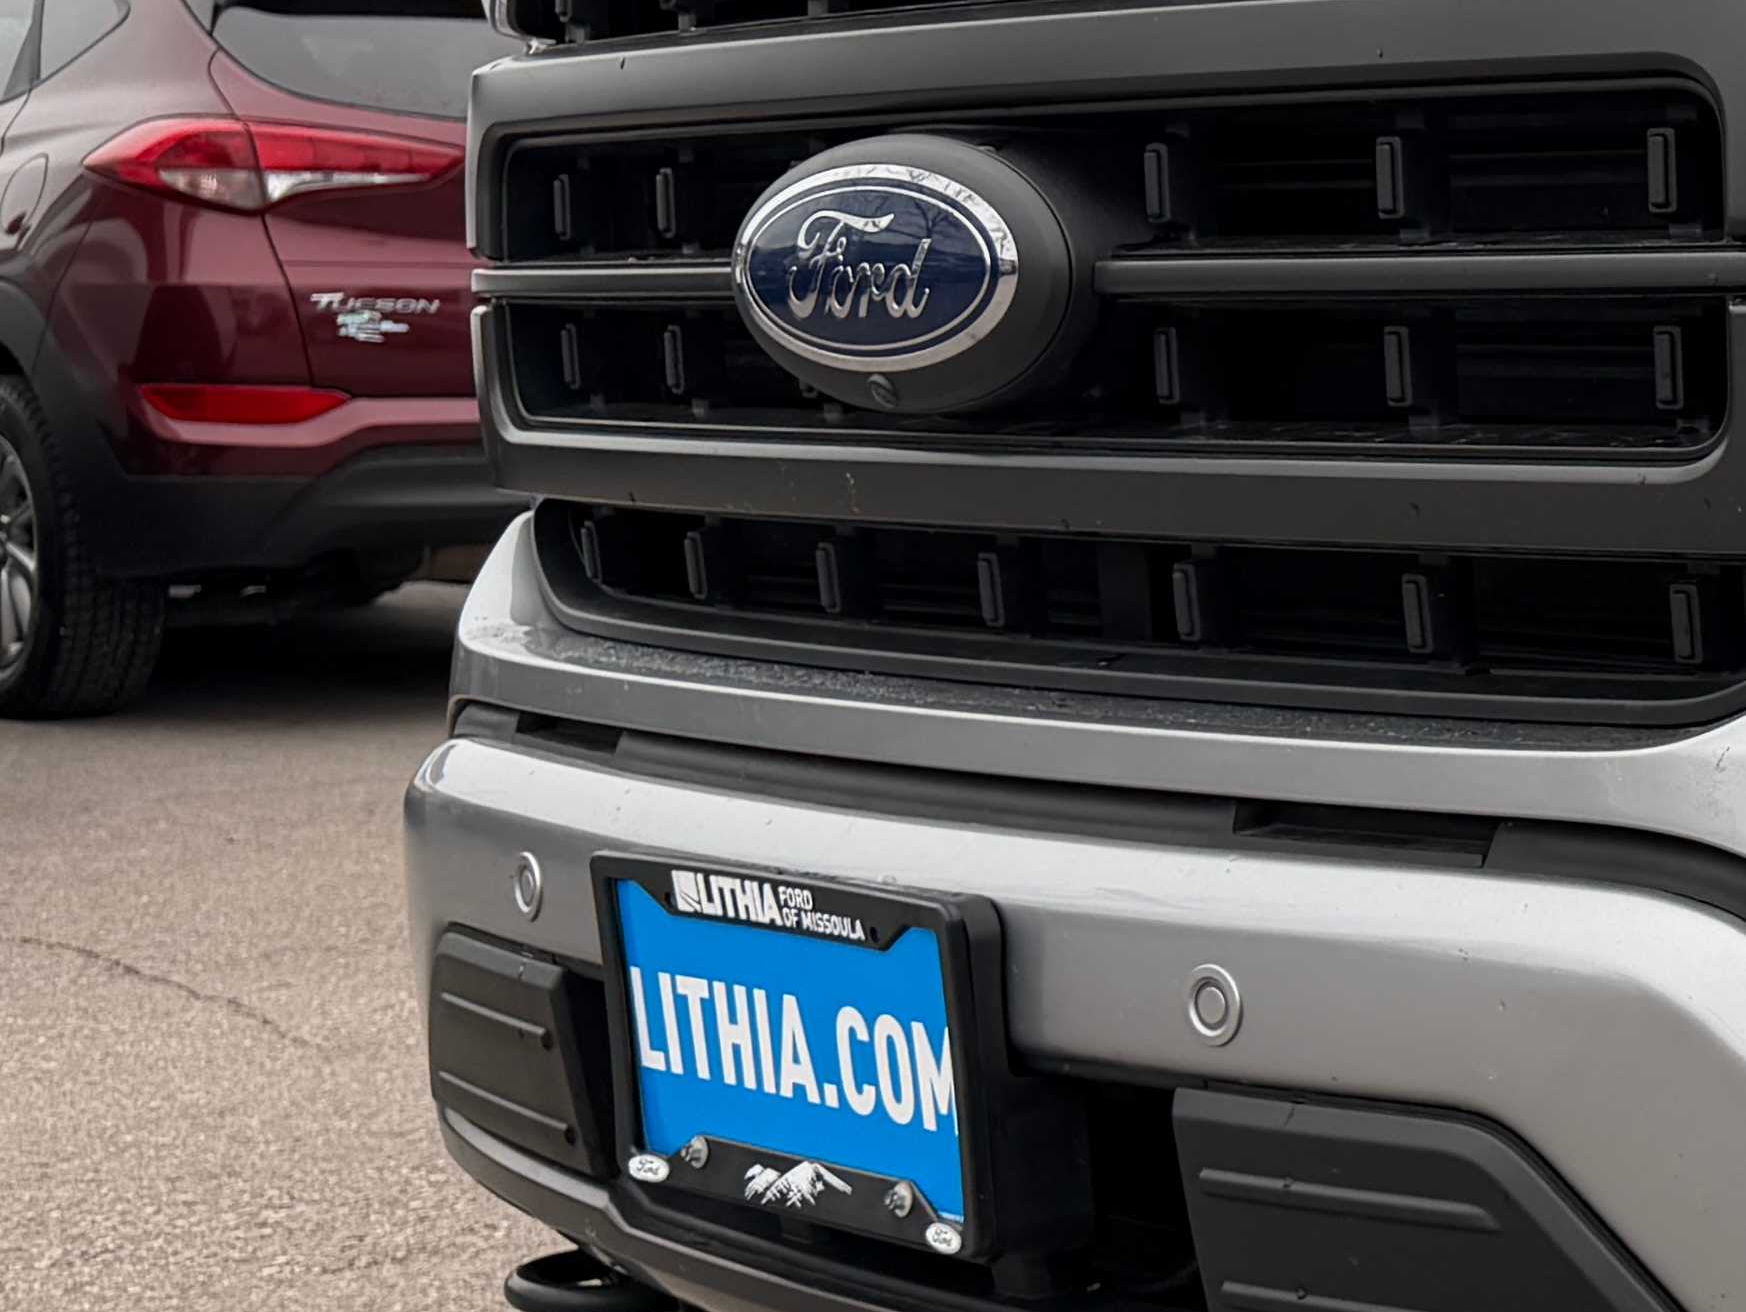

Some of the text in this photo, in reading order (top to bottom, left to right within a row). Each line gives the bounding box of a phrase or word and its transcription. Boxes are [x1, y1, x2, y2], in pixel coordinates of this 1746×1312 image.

[786, 209, 932, 319] Ford
[310, 291, 441, 315] TUCSON
[696, 872, 813, 927] LITHIA FORD
[782, 907, 867, 941] OF MISSOULA
[629, 966, 960, 1136] LITHIA.COM
